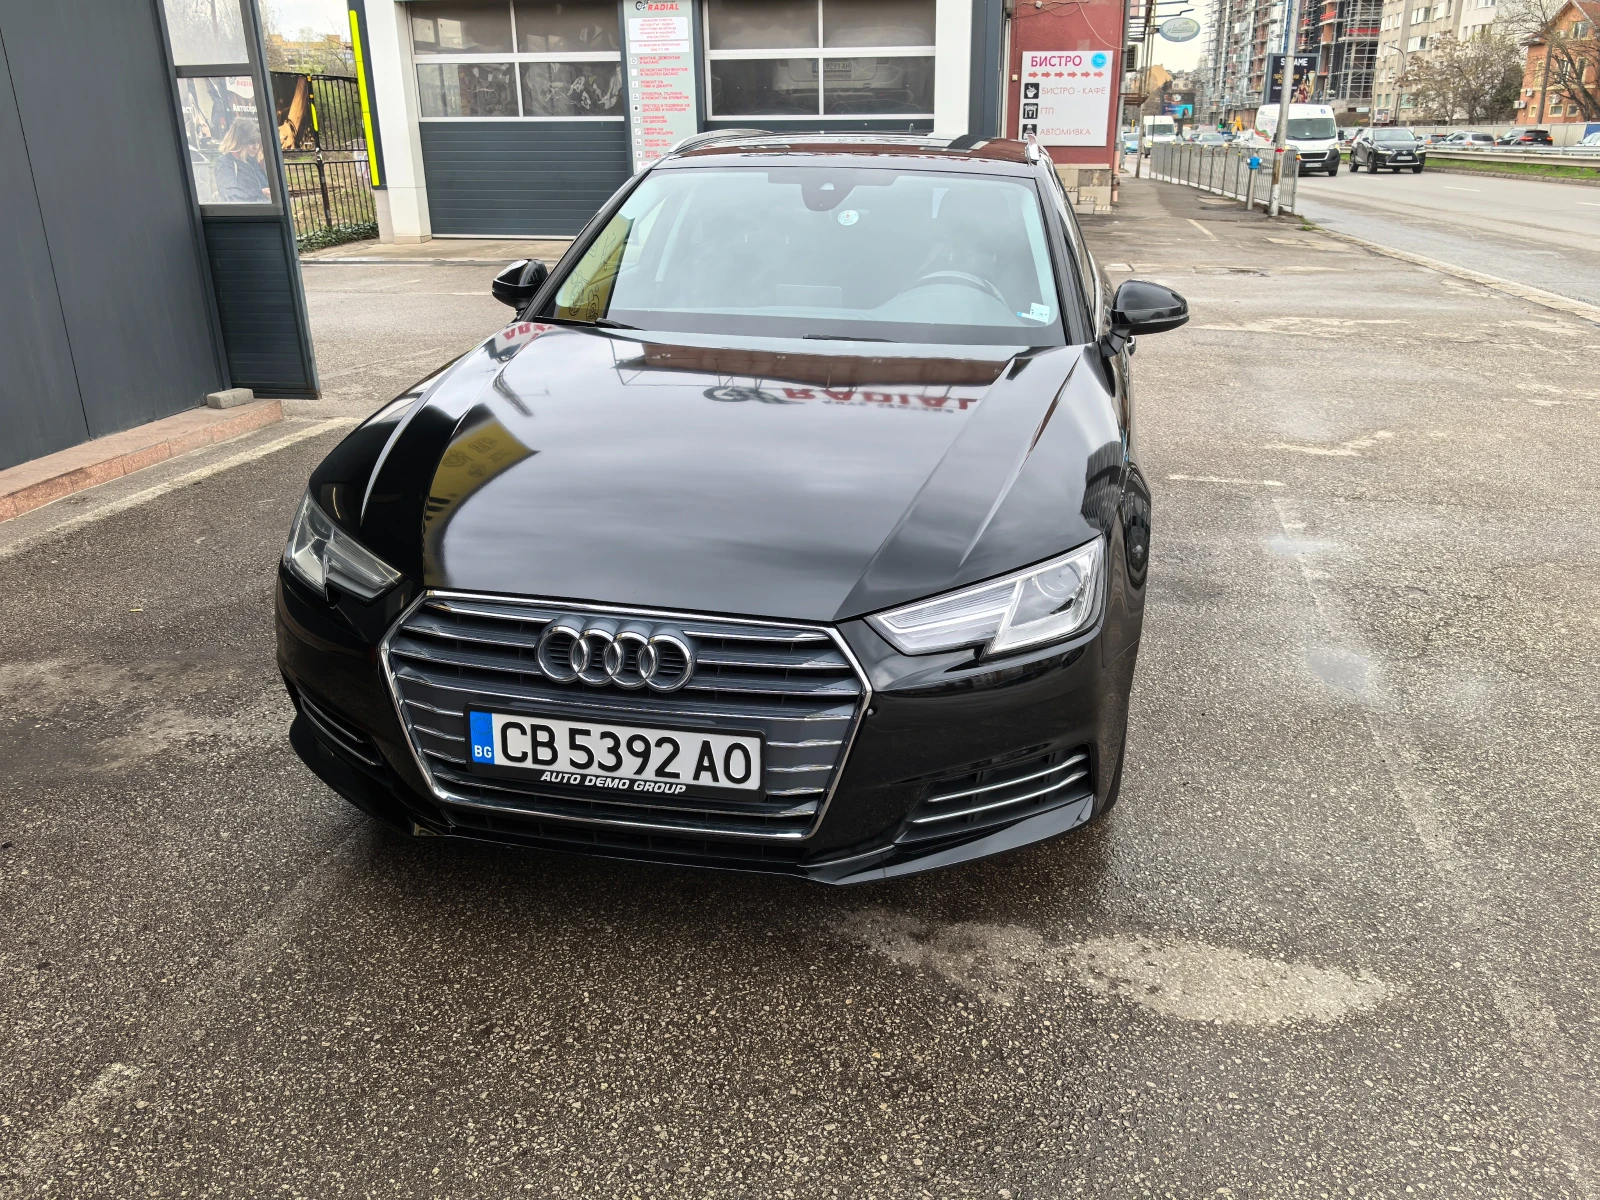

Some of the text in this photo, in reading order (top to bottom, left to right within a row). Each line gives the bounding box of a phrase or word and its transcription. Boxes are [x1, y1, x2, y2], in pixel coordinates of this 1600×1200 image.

[1031, 55, 1082, 67] БИСТРО
[1280, 58, 1308, 66] SAME
[1041, 87, 1075, 95] БИСТРО
[1083, 87, 1106, 95] КАФЕ
[1040, 107, 1055, 115] ГТП
[1040, 128, 1091, 136] АВТОМИВКА
[474, 745, 492, 758] BG
[501, 721, 752, 784] CB 5392 AO
[540, 771, 686, 794] AUTO DEMO GROUP
